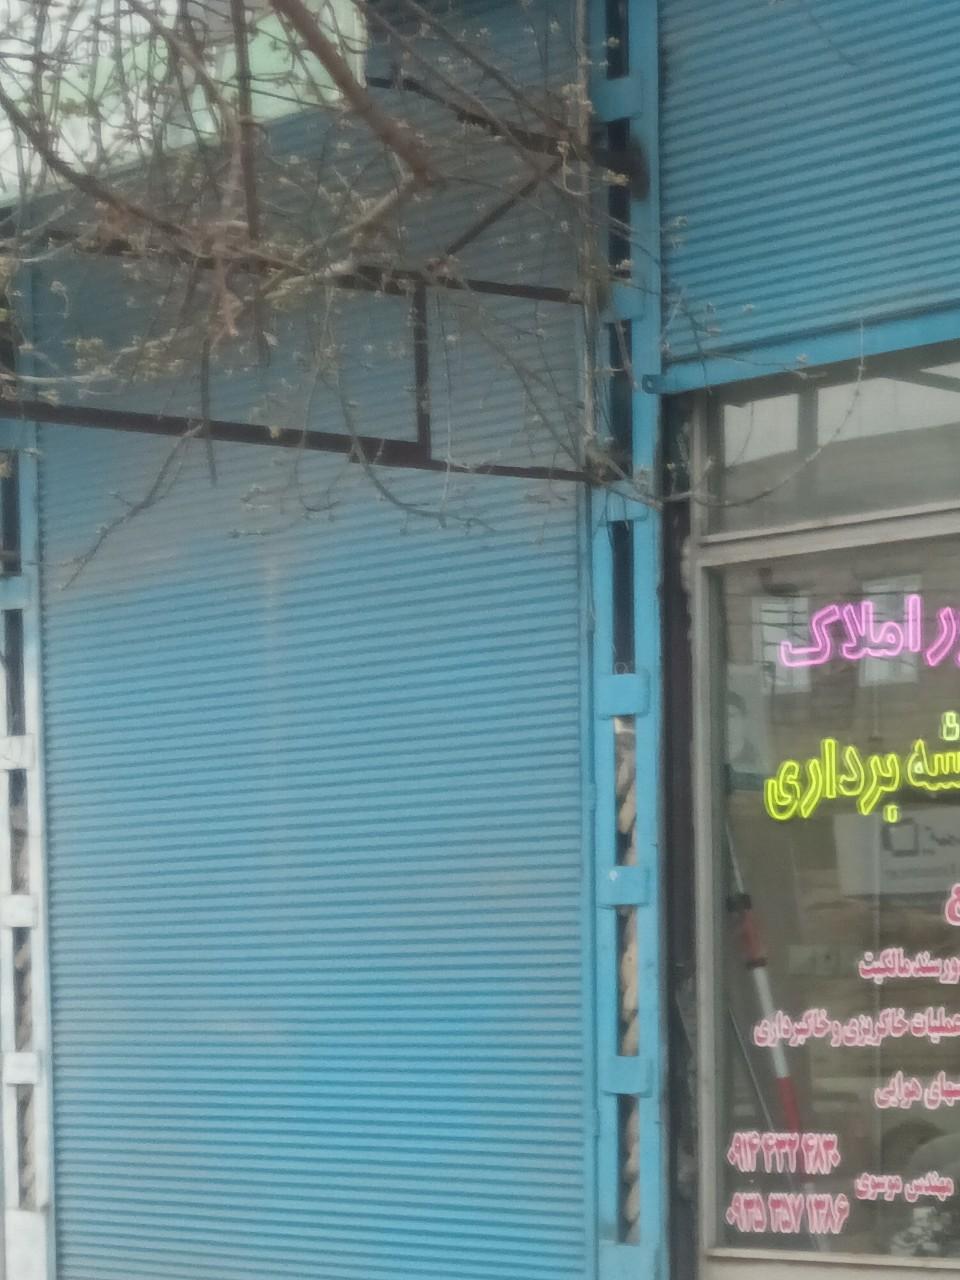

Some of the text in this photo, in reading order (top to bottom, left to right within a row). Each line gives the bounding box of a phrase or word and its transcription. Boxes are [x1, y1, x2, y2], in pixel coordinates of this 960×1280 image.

[779, 593, 922, 668] املاک
[764, 737, 902, 823] برداری
[858, 948, 911, 985] مالکیت
[911, 951, 942, 978] سند
[874, 1070, 922, 1109] هوایی
[726, 1131, 761, 1173] ۰۹۱۴
[854, 1171, 903, 1202] موسوی
[904, 1170, 955, 1203] مهندس
